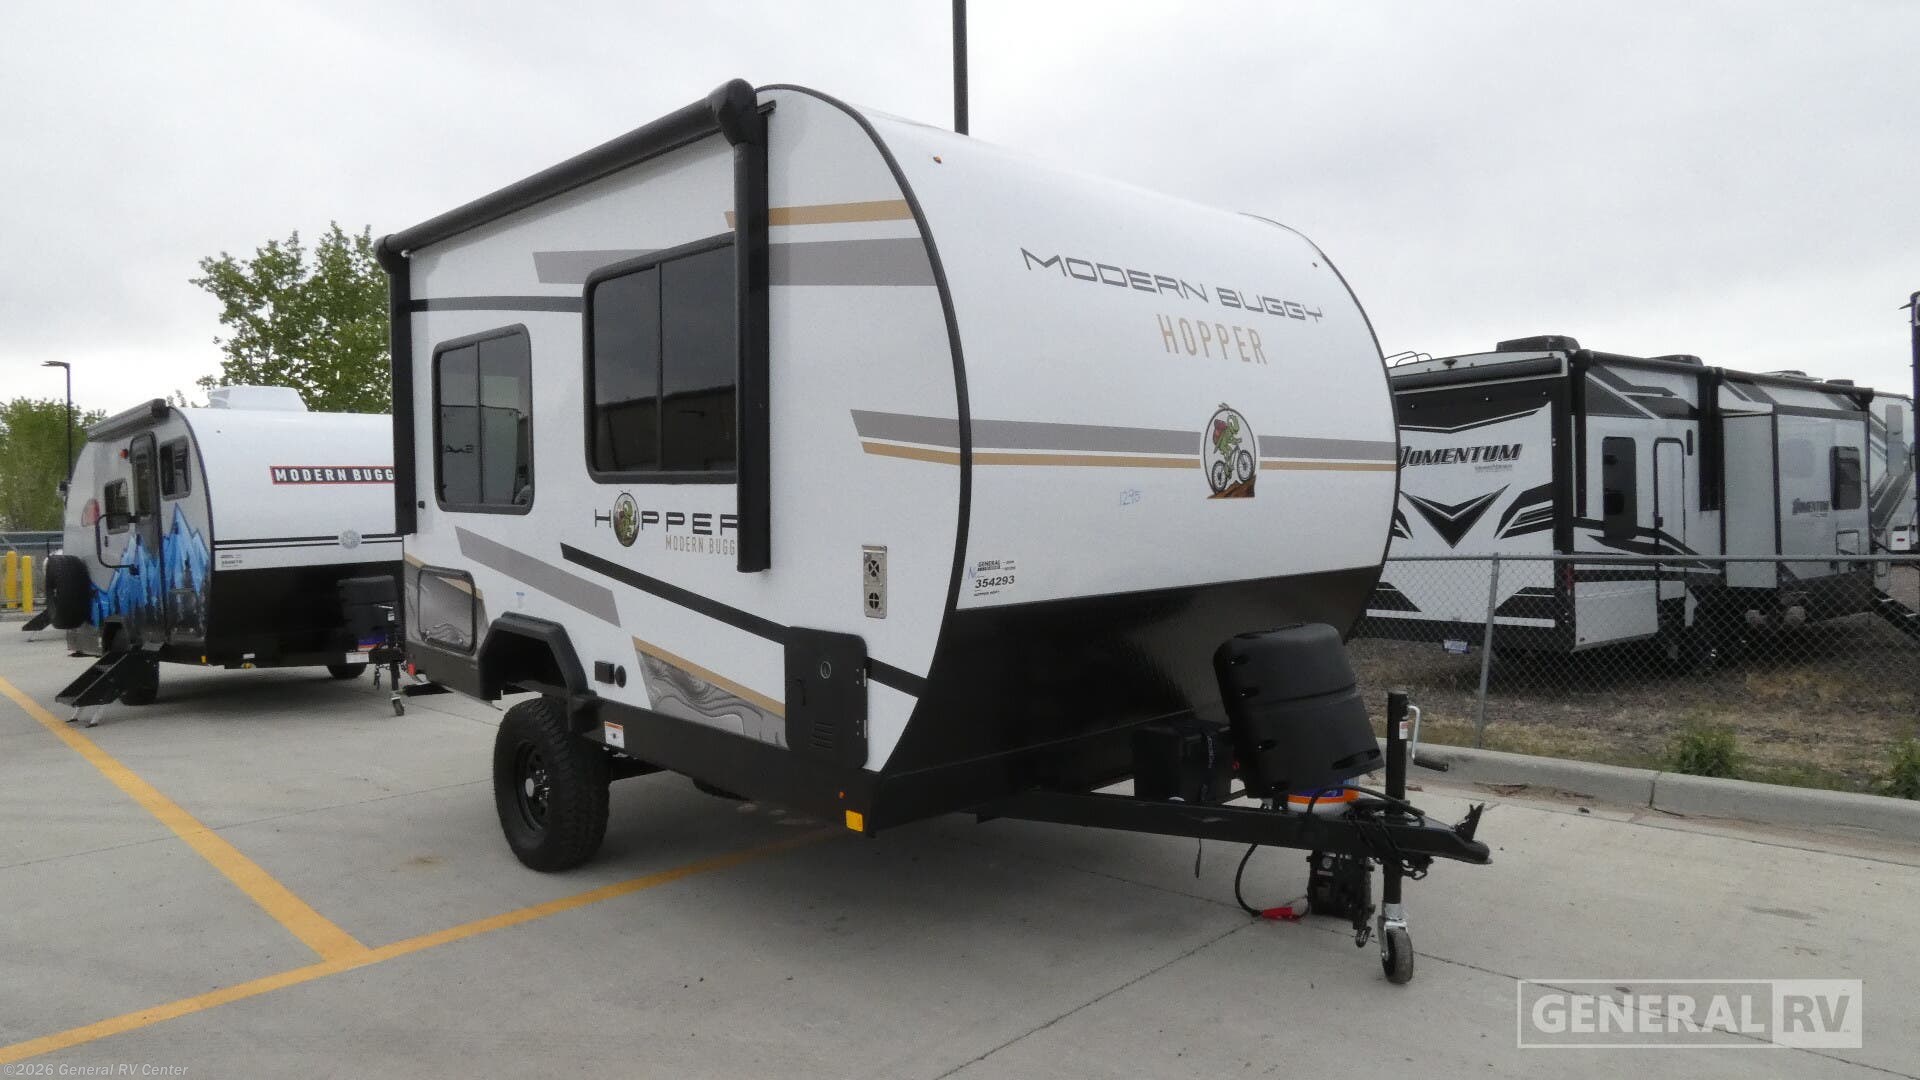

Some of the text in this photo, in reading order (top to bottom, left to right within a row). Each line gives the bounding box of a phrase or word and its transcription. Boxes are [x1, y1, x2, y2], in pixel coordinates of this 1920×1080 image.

[1020, 247, 1324, 323] MODERN BUGGY
[1157, 313, 1268, 365] HOPPER
[274, 468, 394, 482] MODERN BUGG
[665, 535, 736, 556] MODERN BUGG
[975, 575, 1015, 589] 354293
